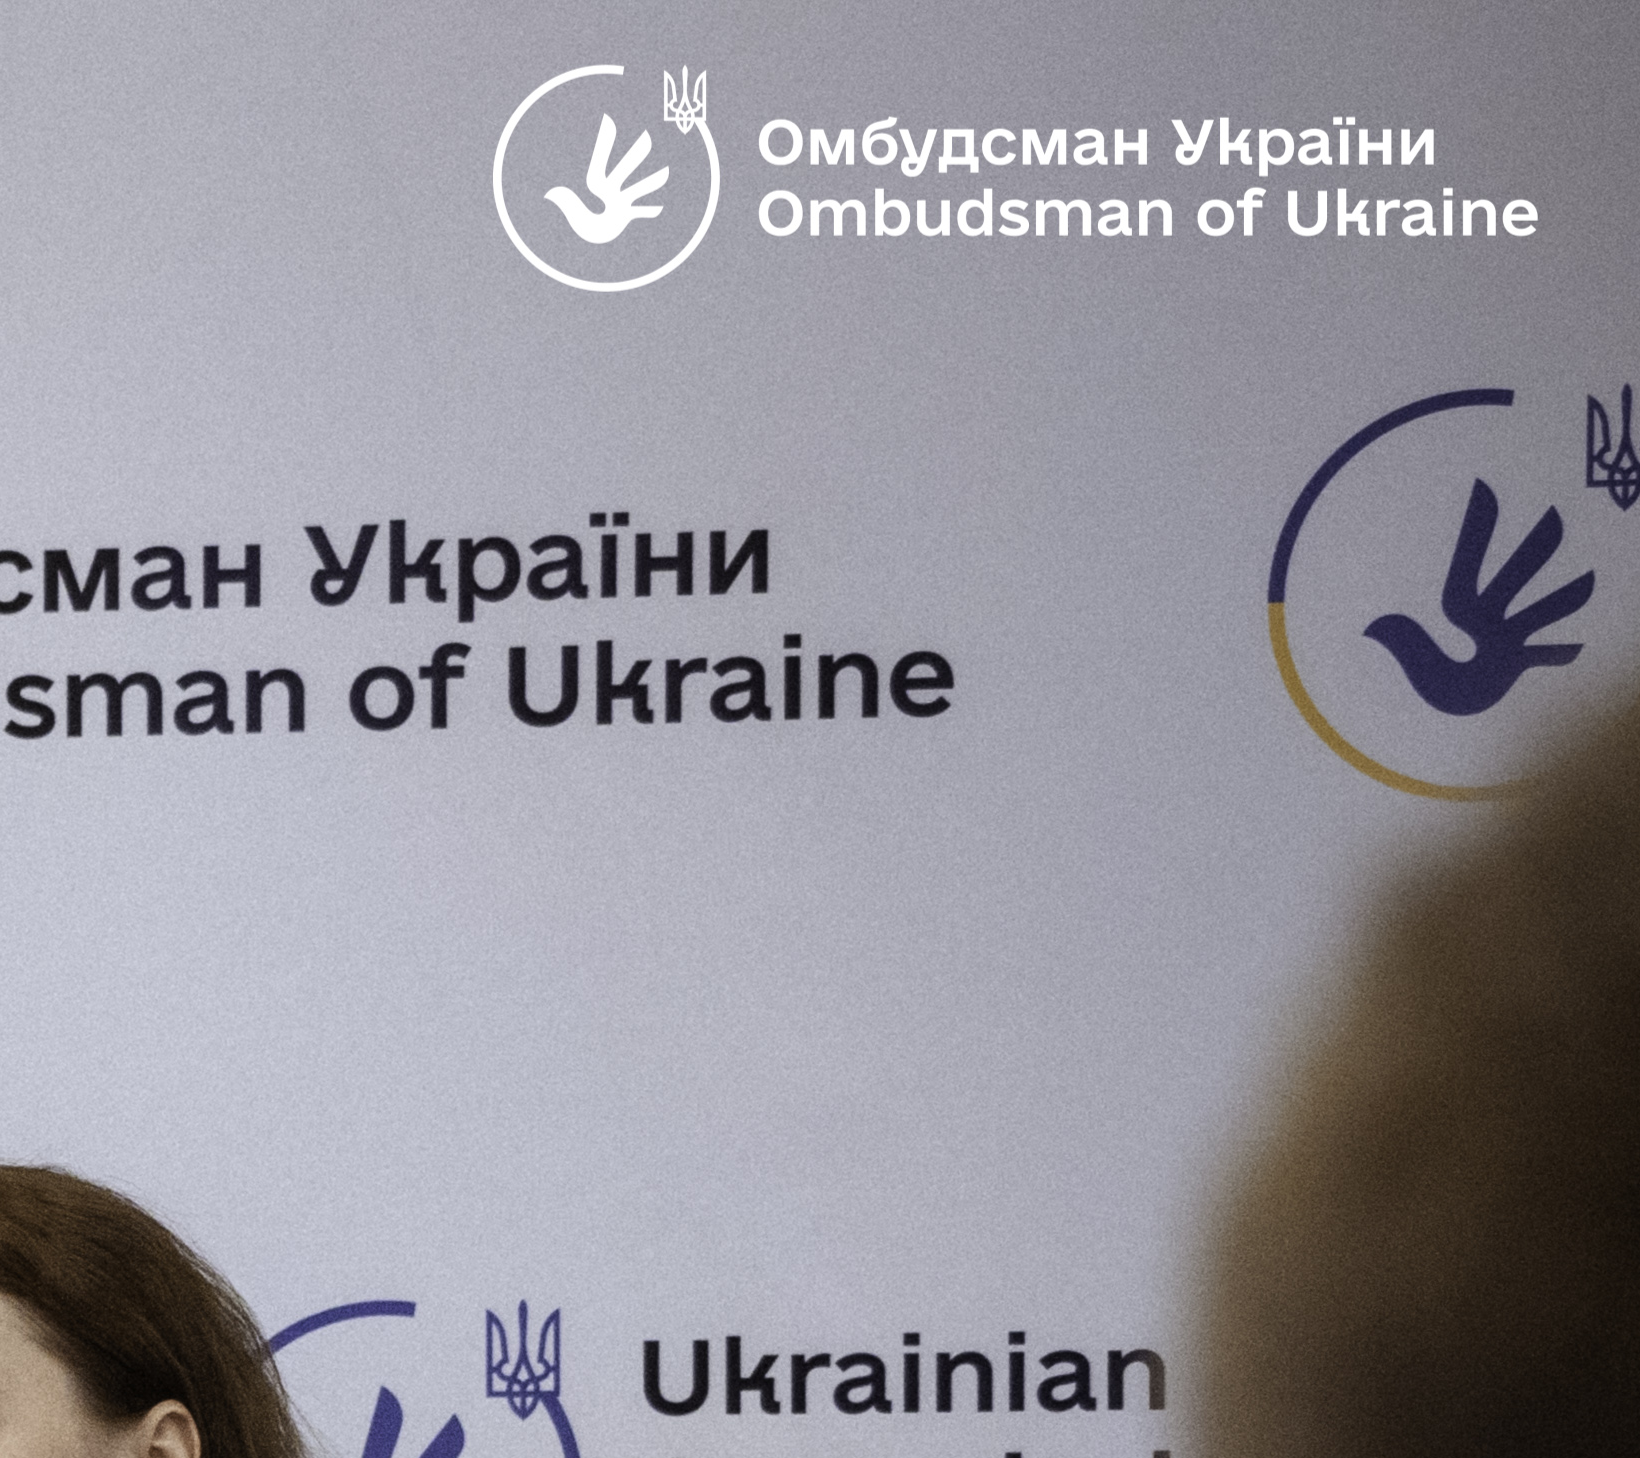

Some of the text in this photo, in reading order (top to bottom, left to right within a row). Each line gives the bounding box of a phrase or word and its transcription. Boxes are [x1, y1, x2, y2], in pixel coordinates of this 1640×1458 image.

[306, 511, 770, 623] України
[349, 642, 470, 731] of
[508, 633, 955, 729] Ukraine
[644, 1331, 1167, 1416] Ukrainian
